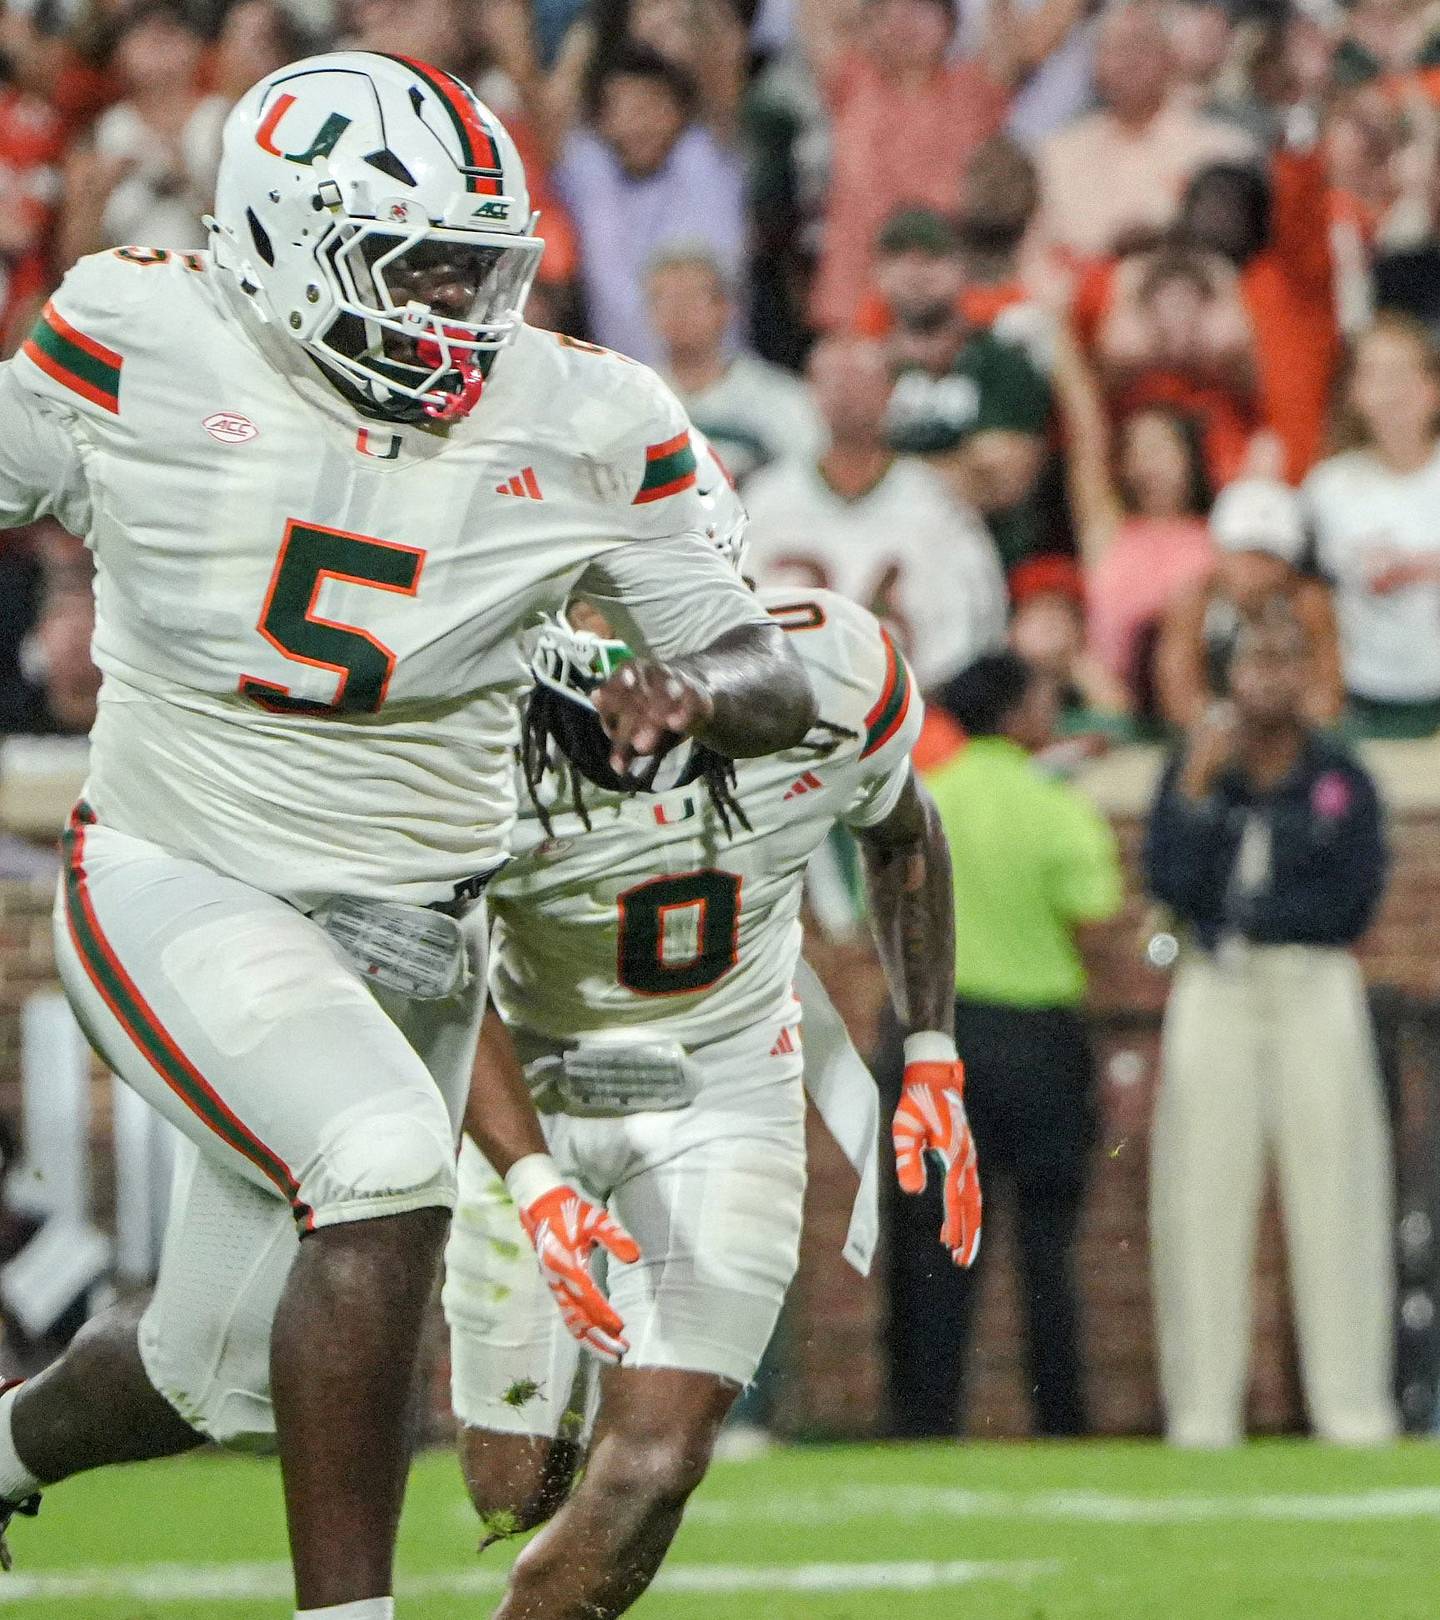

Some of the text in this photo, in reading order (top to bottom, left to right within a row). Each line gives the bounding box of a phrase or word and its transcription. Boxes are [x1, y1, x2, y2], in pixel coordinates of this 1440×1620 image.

[255, 93, 352, 166] U
[471, 202, 511, 220] ACC
[211, 419, 251, 437] ACC
[356, 426, 403, 459] U
[238, 517, 427, 714] 5
[654, 797, 696, 826] U
[616, 867, 743, 997] 0
